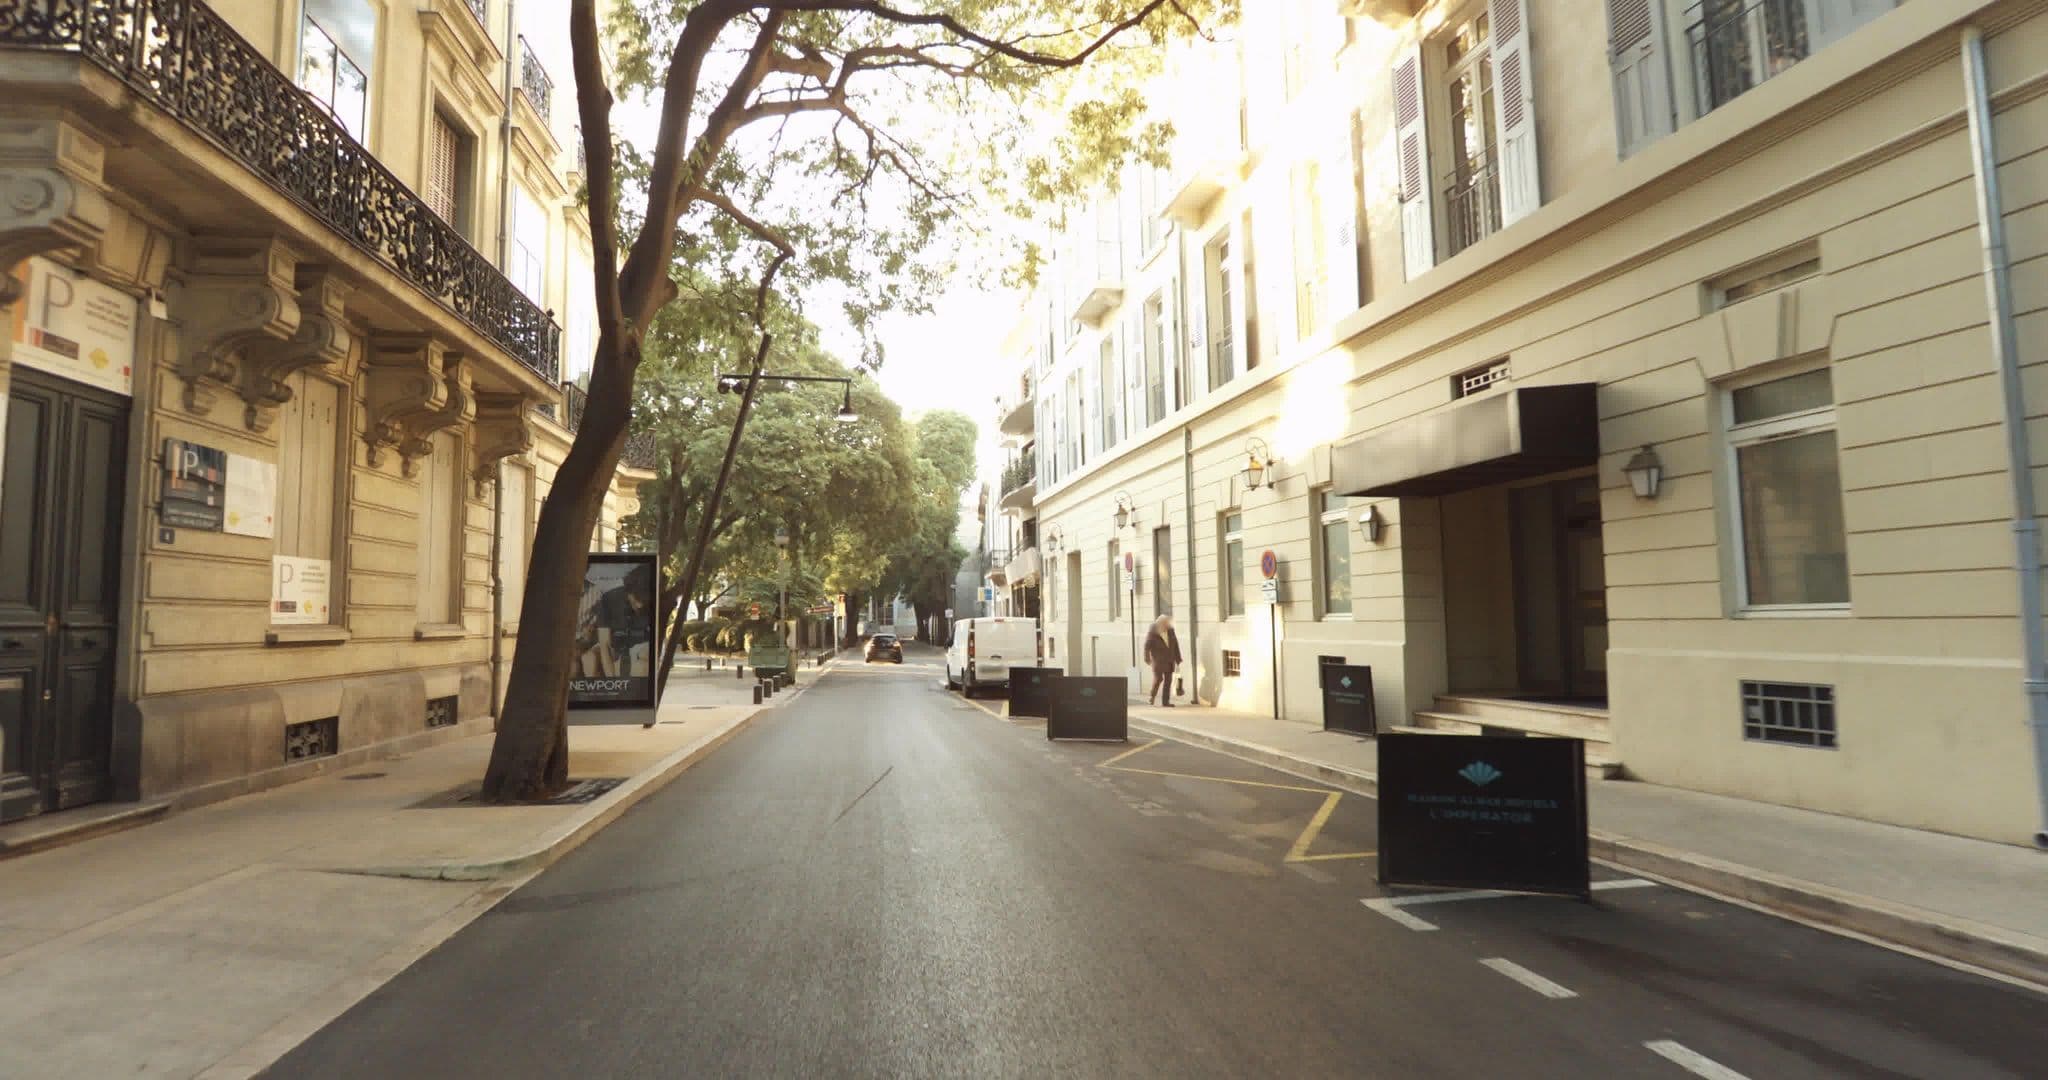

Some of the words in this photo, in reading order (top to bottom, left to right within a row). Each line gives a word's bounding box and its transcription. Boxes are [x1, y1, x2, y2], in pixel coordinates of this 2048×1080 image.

[43, 271, 74, 329] P
[280, 563, 294, 598] P
[569, 680, 629, 691] NEWPORT
